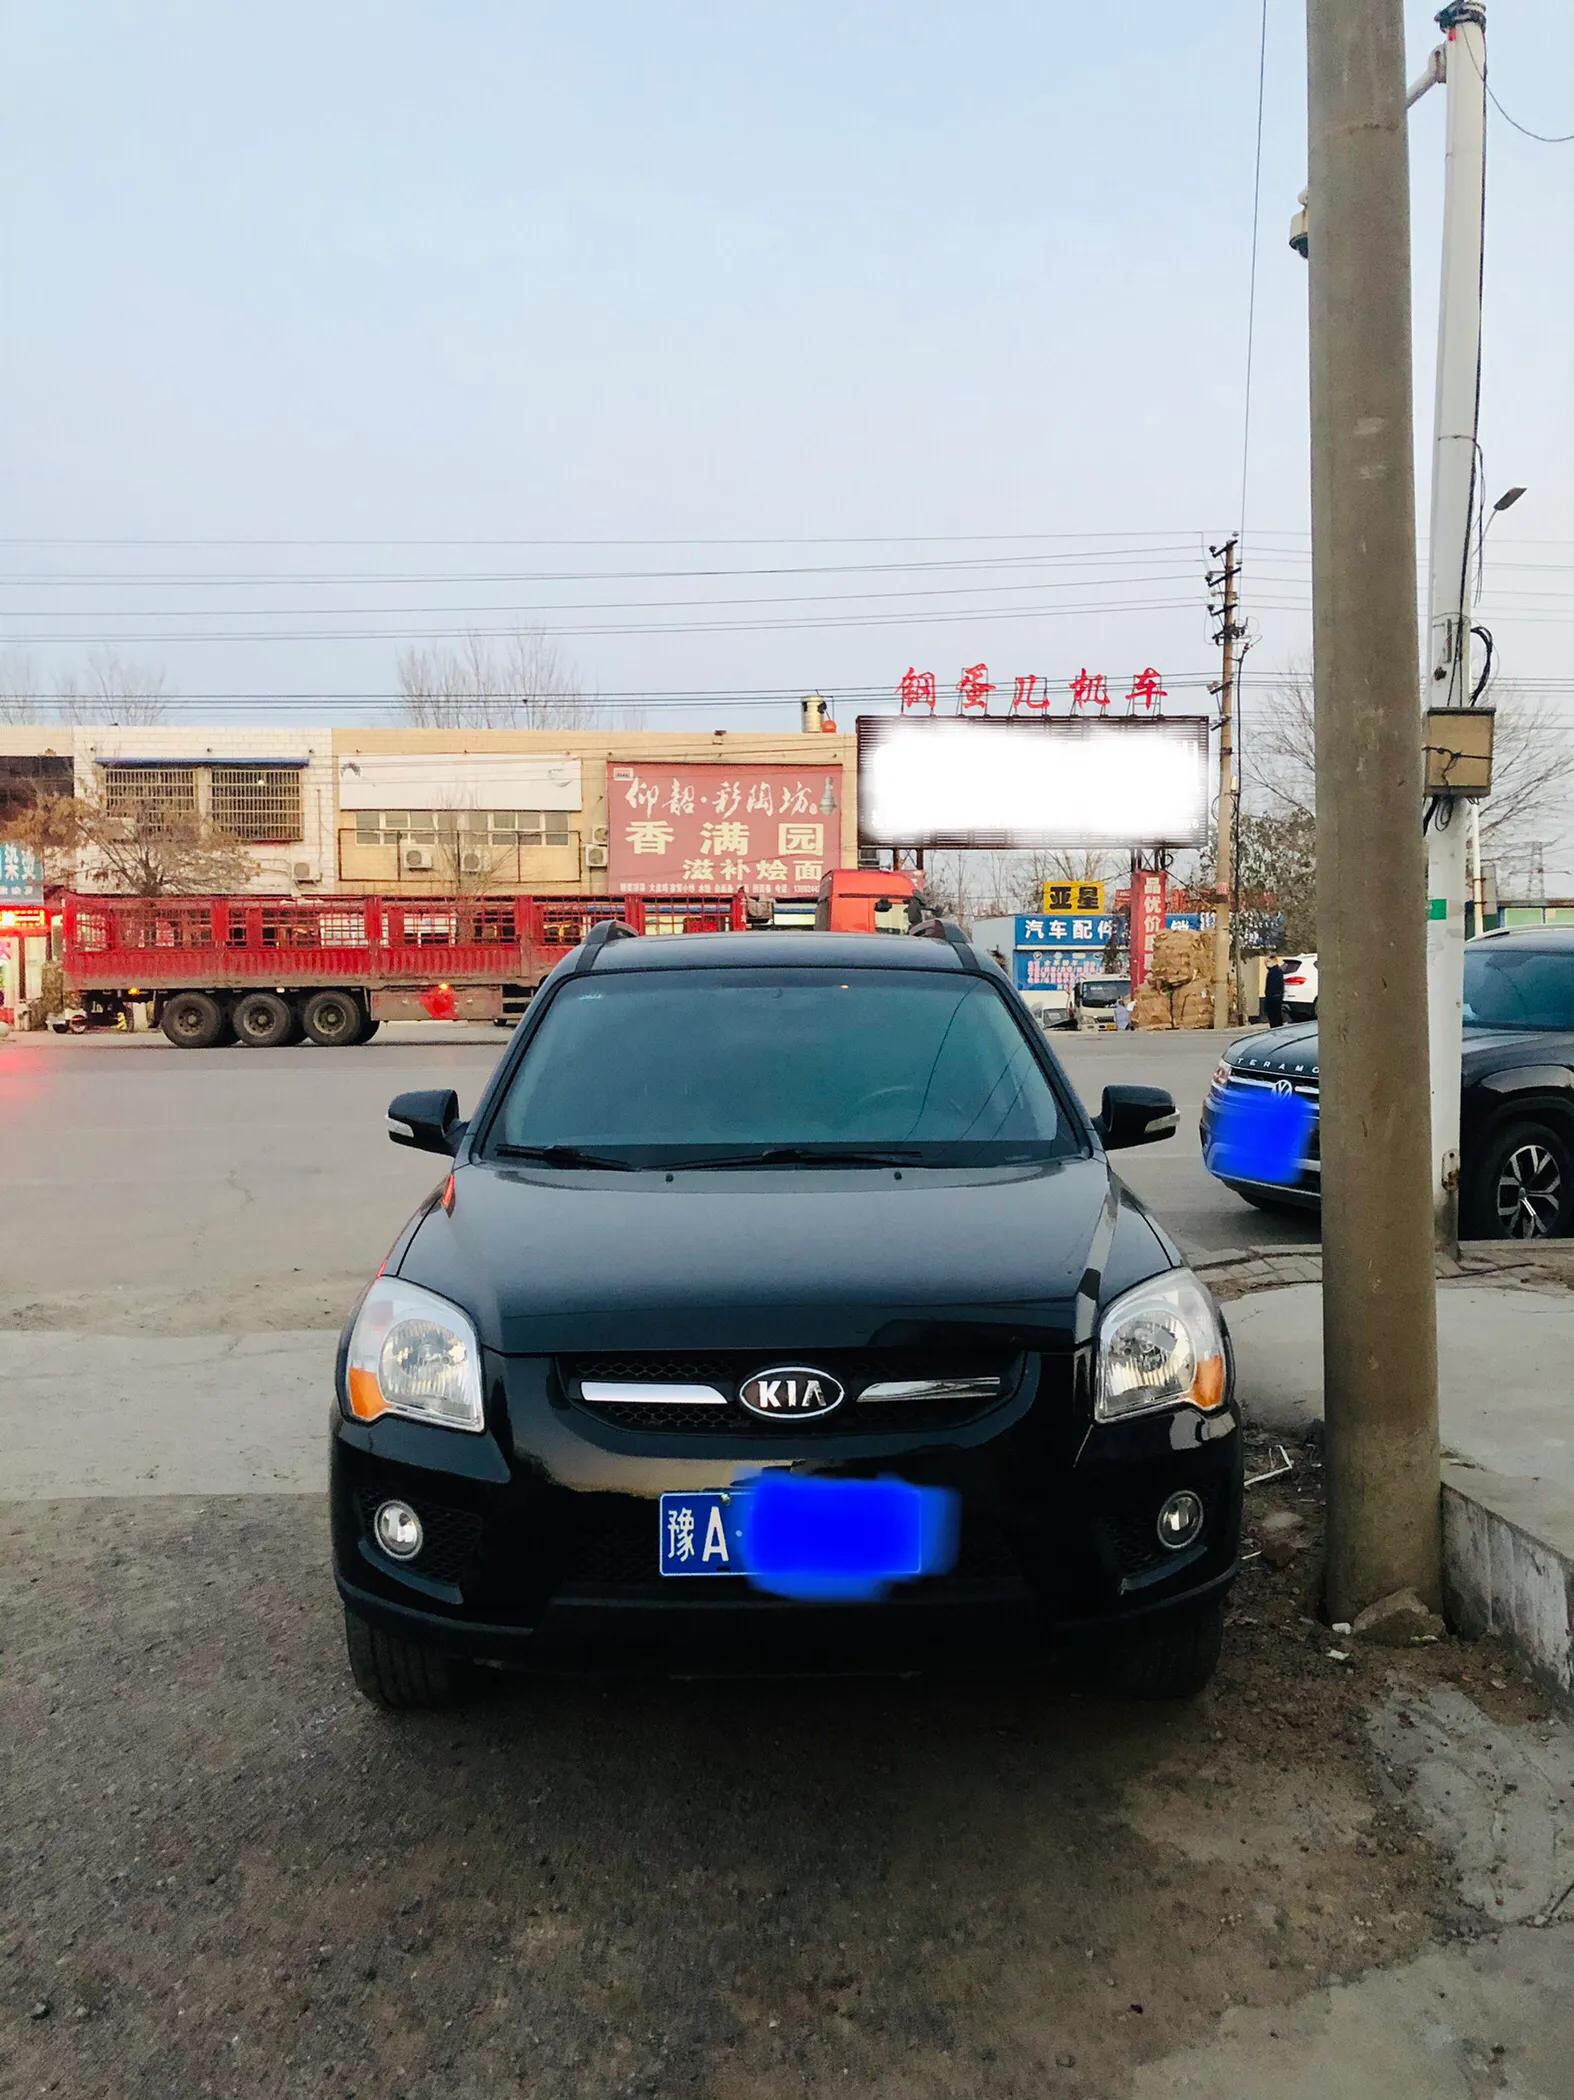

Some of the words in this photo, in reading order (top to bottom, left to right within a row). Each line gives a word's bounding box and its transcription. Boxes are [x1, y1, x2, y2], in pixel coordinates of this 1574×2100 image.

[625, 820, 825, 857] 香满园
[682, 858, 825, 882] 滋补烩面
[1049, 886, 1100, 910] 亚星
[757, 1379, 827, 1408] KIA
